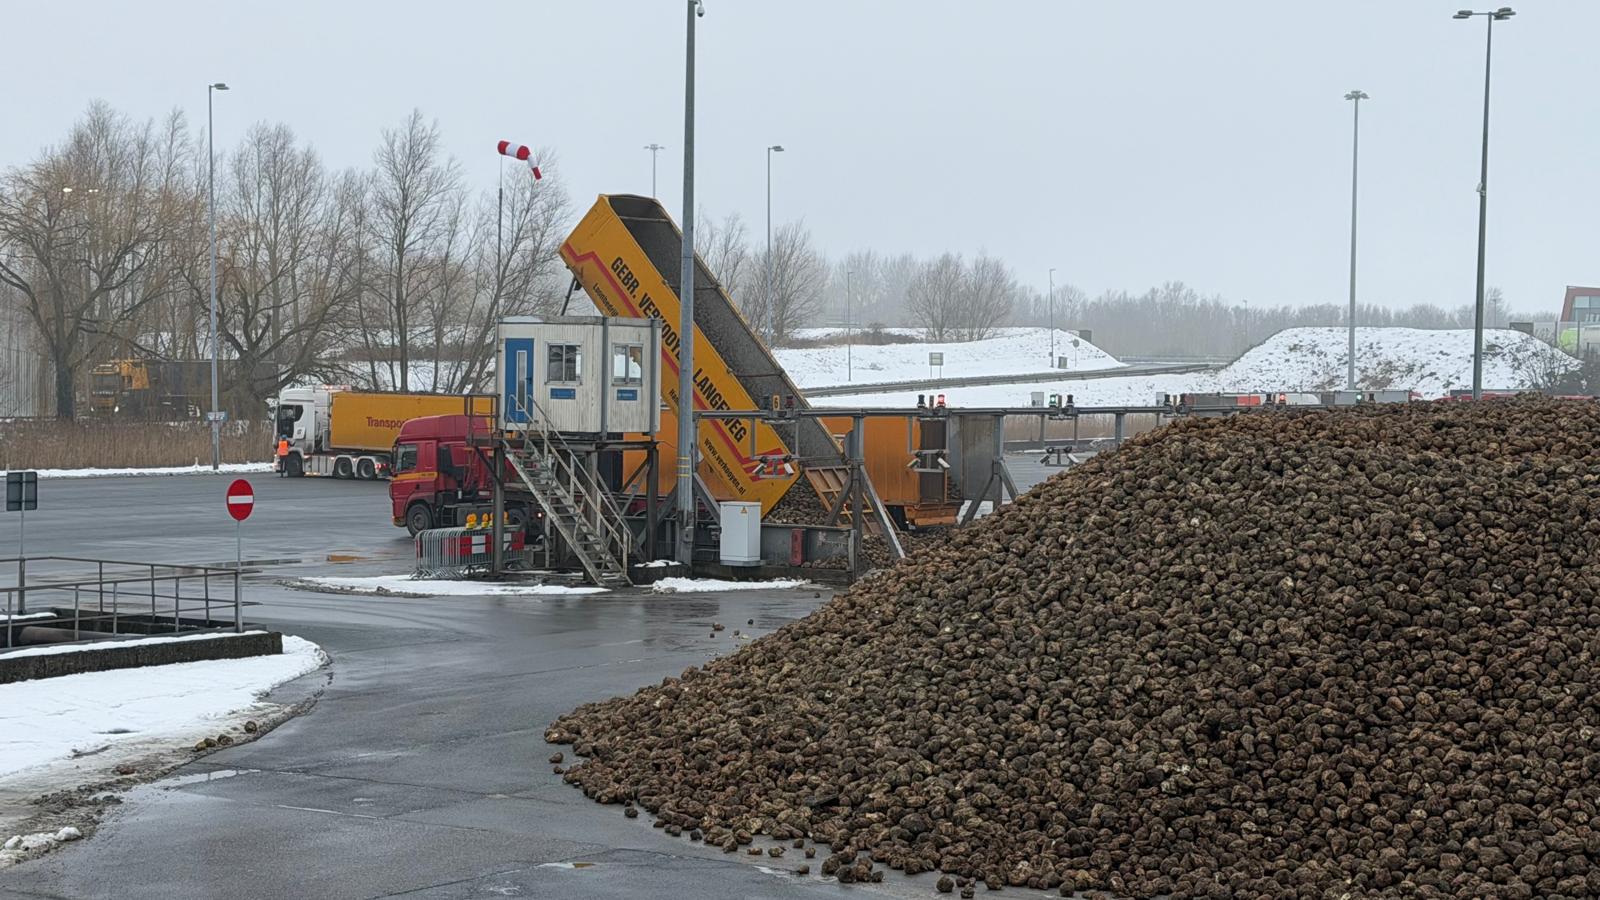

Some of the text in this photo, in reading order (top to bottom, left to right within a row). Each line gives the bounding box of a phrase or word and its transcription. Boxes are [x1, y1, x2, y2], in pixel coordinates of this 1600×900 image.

[611, 256, 640, 299] GEBR.
[639, 293, 694, 361] VEROOY
[704, 438, 747, 496] www.verkooyen.nl
